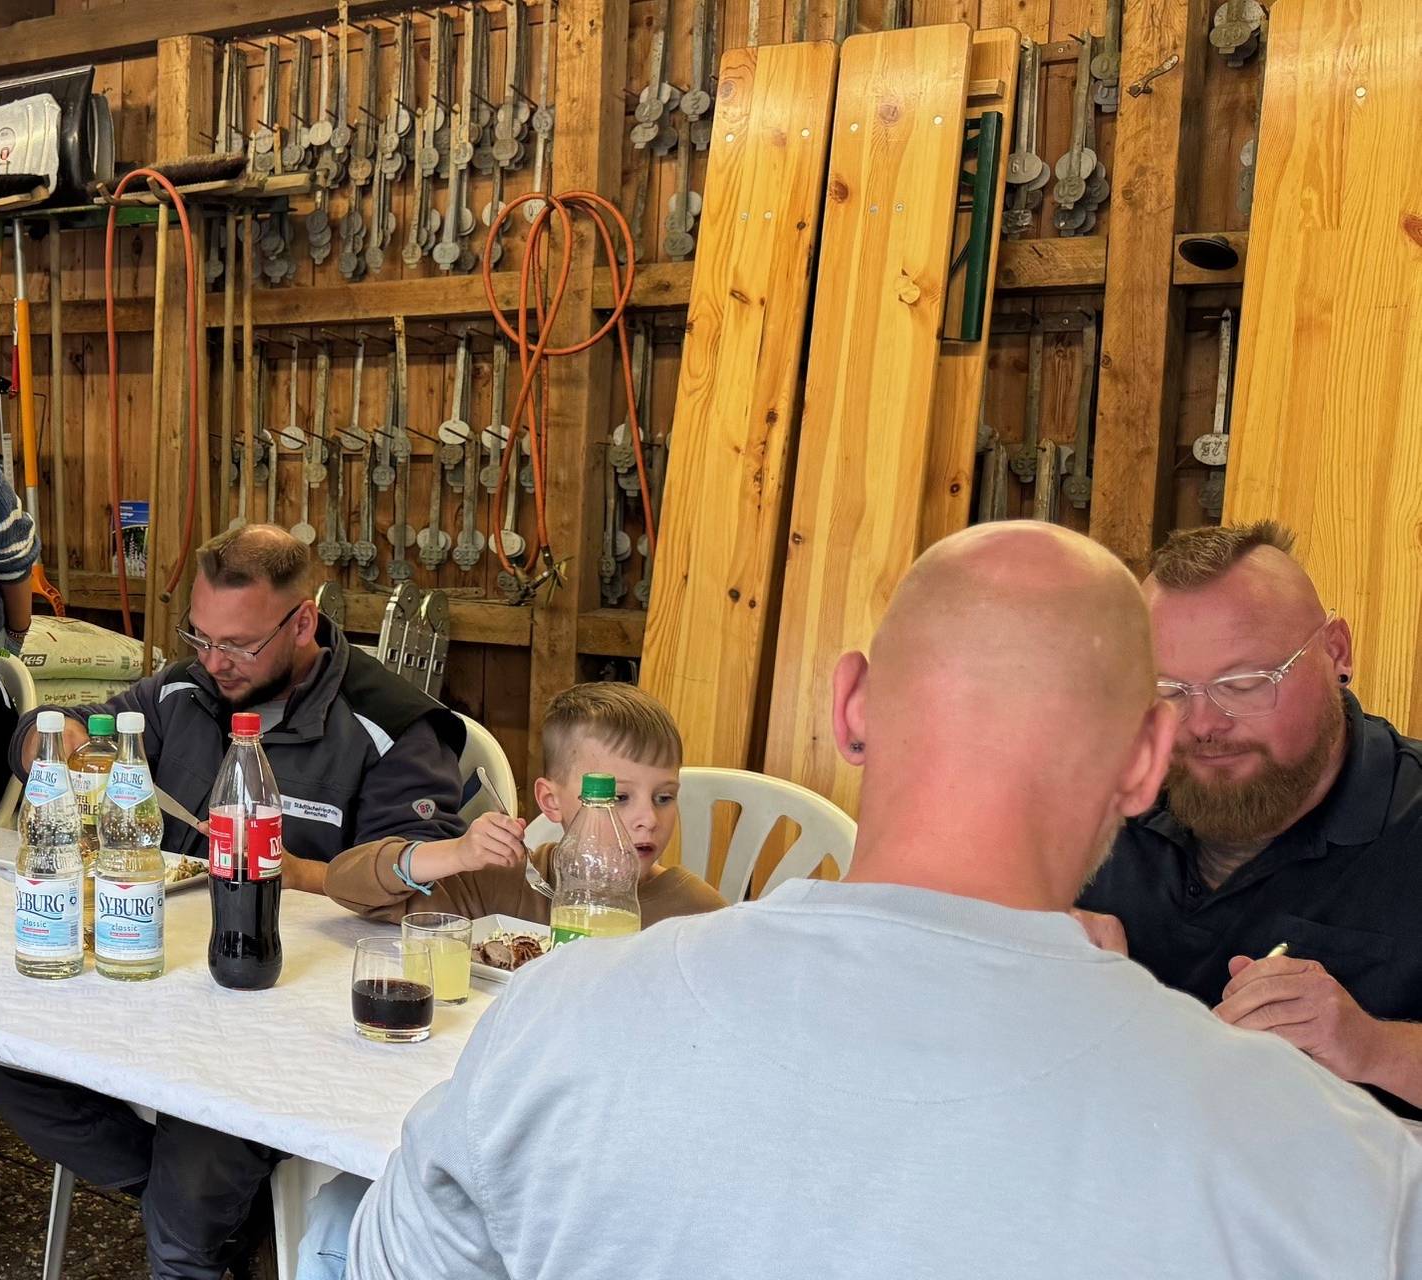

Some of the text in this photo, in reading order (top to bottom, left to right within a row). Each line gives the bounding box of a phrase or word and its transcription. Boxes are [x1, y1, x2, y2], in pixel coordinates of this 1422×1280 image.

[23, 656, 44, 665] K+S
[112, 771, 144, 785] SYBURG
[99, 892, 154, 917] SYBURG
[23, 918, 47, 928] classic
[111, 923, 138, 932] classic
